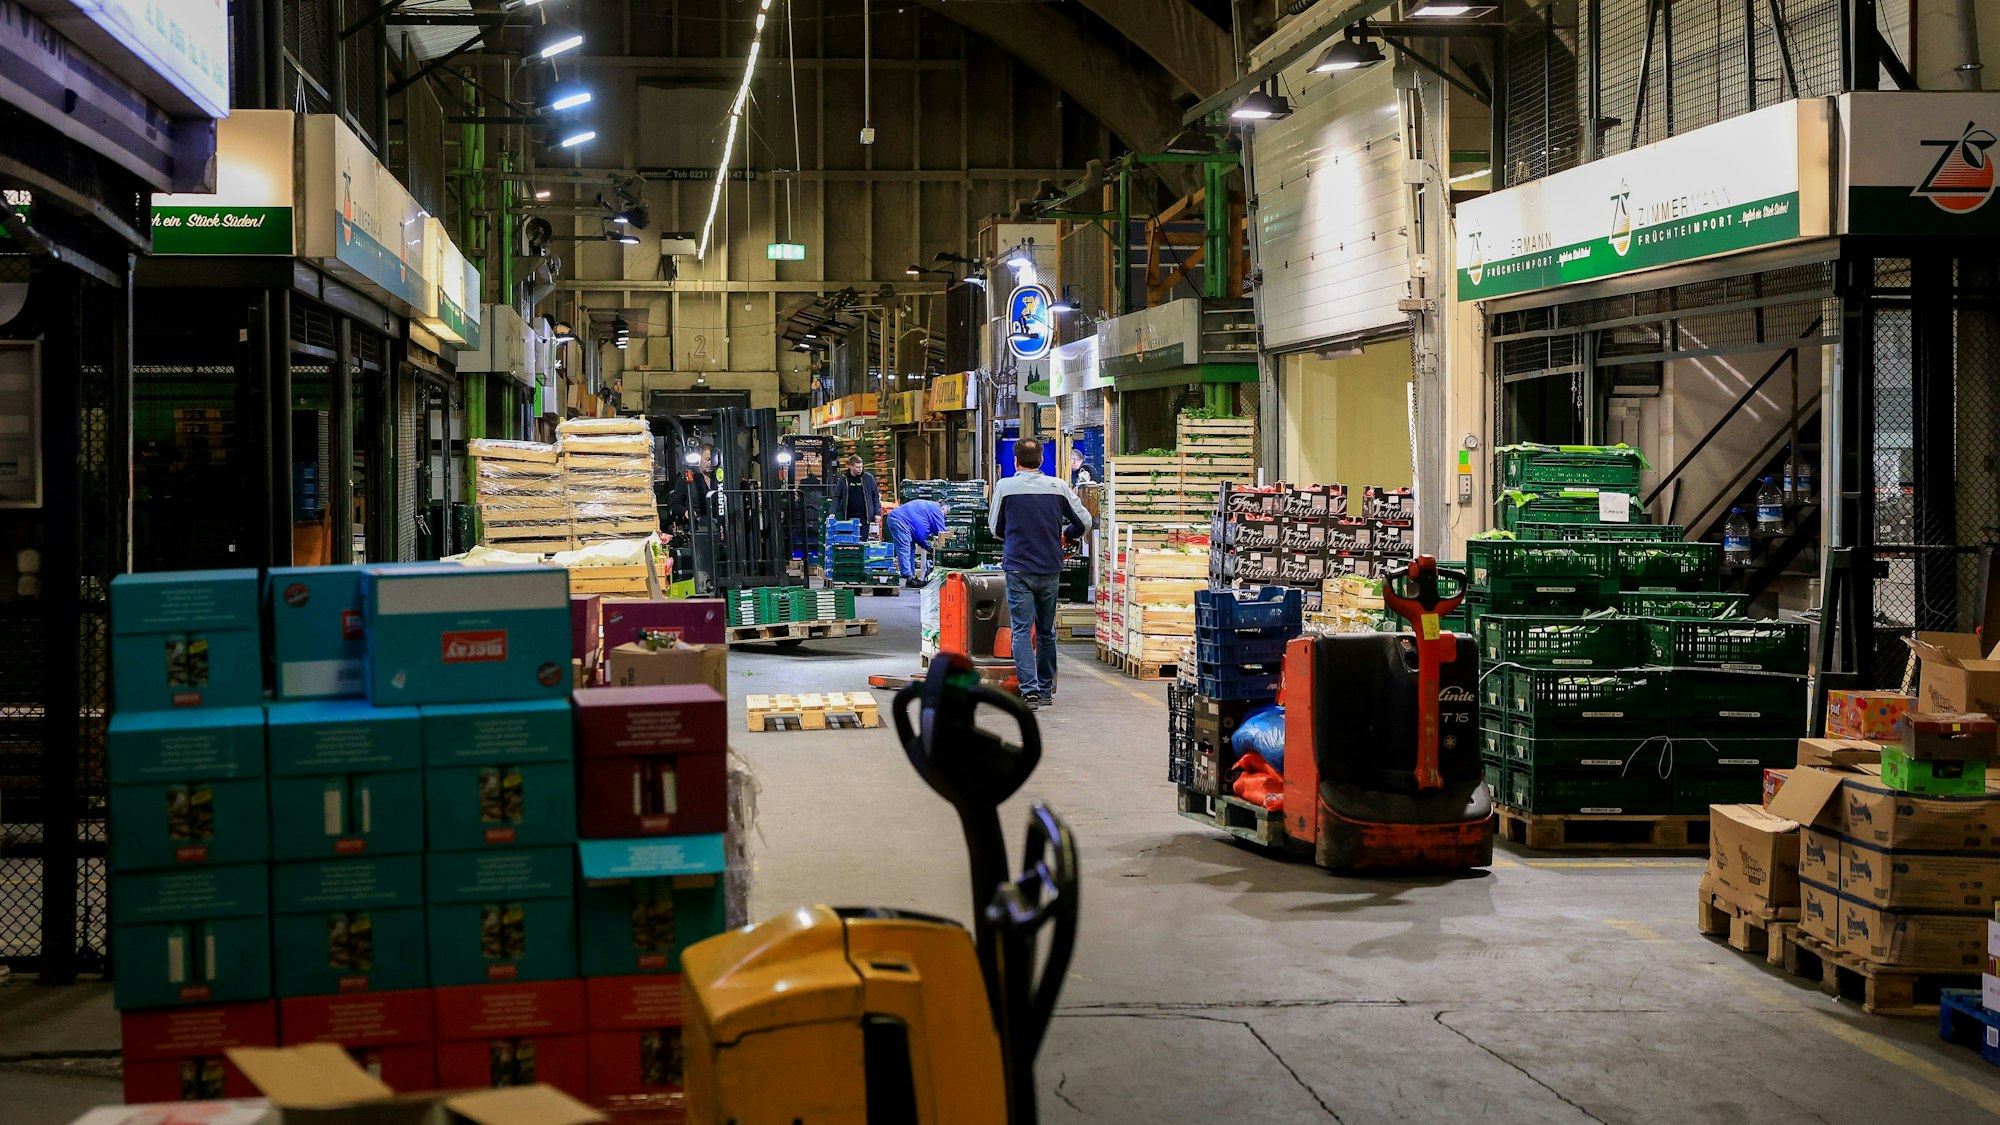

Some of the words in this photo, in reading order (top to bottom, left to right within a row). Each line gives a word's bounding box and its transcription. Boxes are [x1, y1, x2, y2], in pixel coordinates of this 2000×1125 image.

[689, 170, 708, 178] 0221
[733, 170, 742, 178] 47
[163, 215, 181, 227] ein
[186, 213, 221, 227] Stück
[221, 213, 266, 228] Süden!
[1638, 214, 1733, 246] FRÜCHTEIMPORT
[1487, 255, 1553, 277] FRÜCHTEIMPORT
[693, 334, 707, 357] 2
[717, 483, 725, 516] CLARK
[1438, 685, 1475, 702] Linde
[1441, 712, 1453, 723] T
[1455, 712, 1470, 723] 16
[1830, 703, 1841, 715] puf
